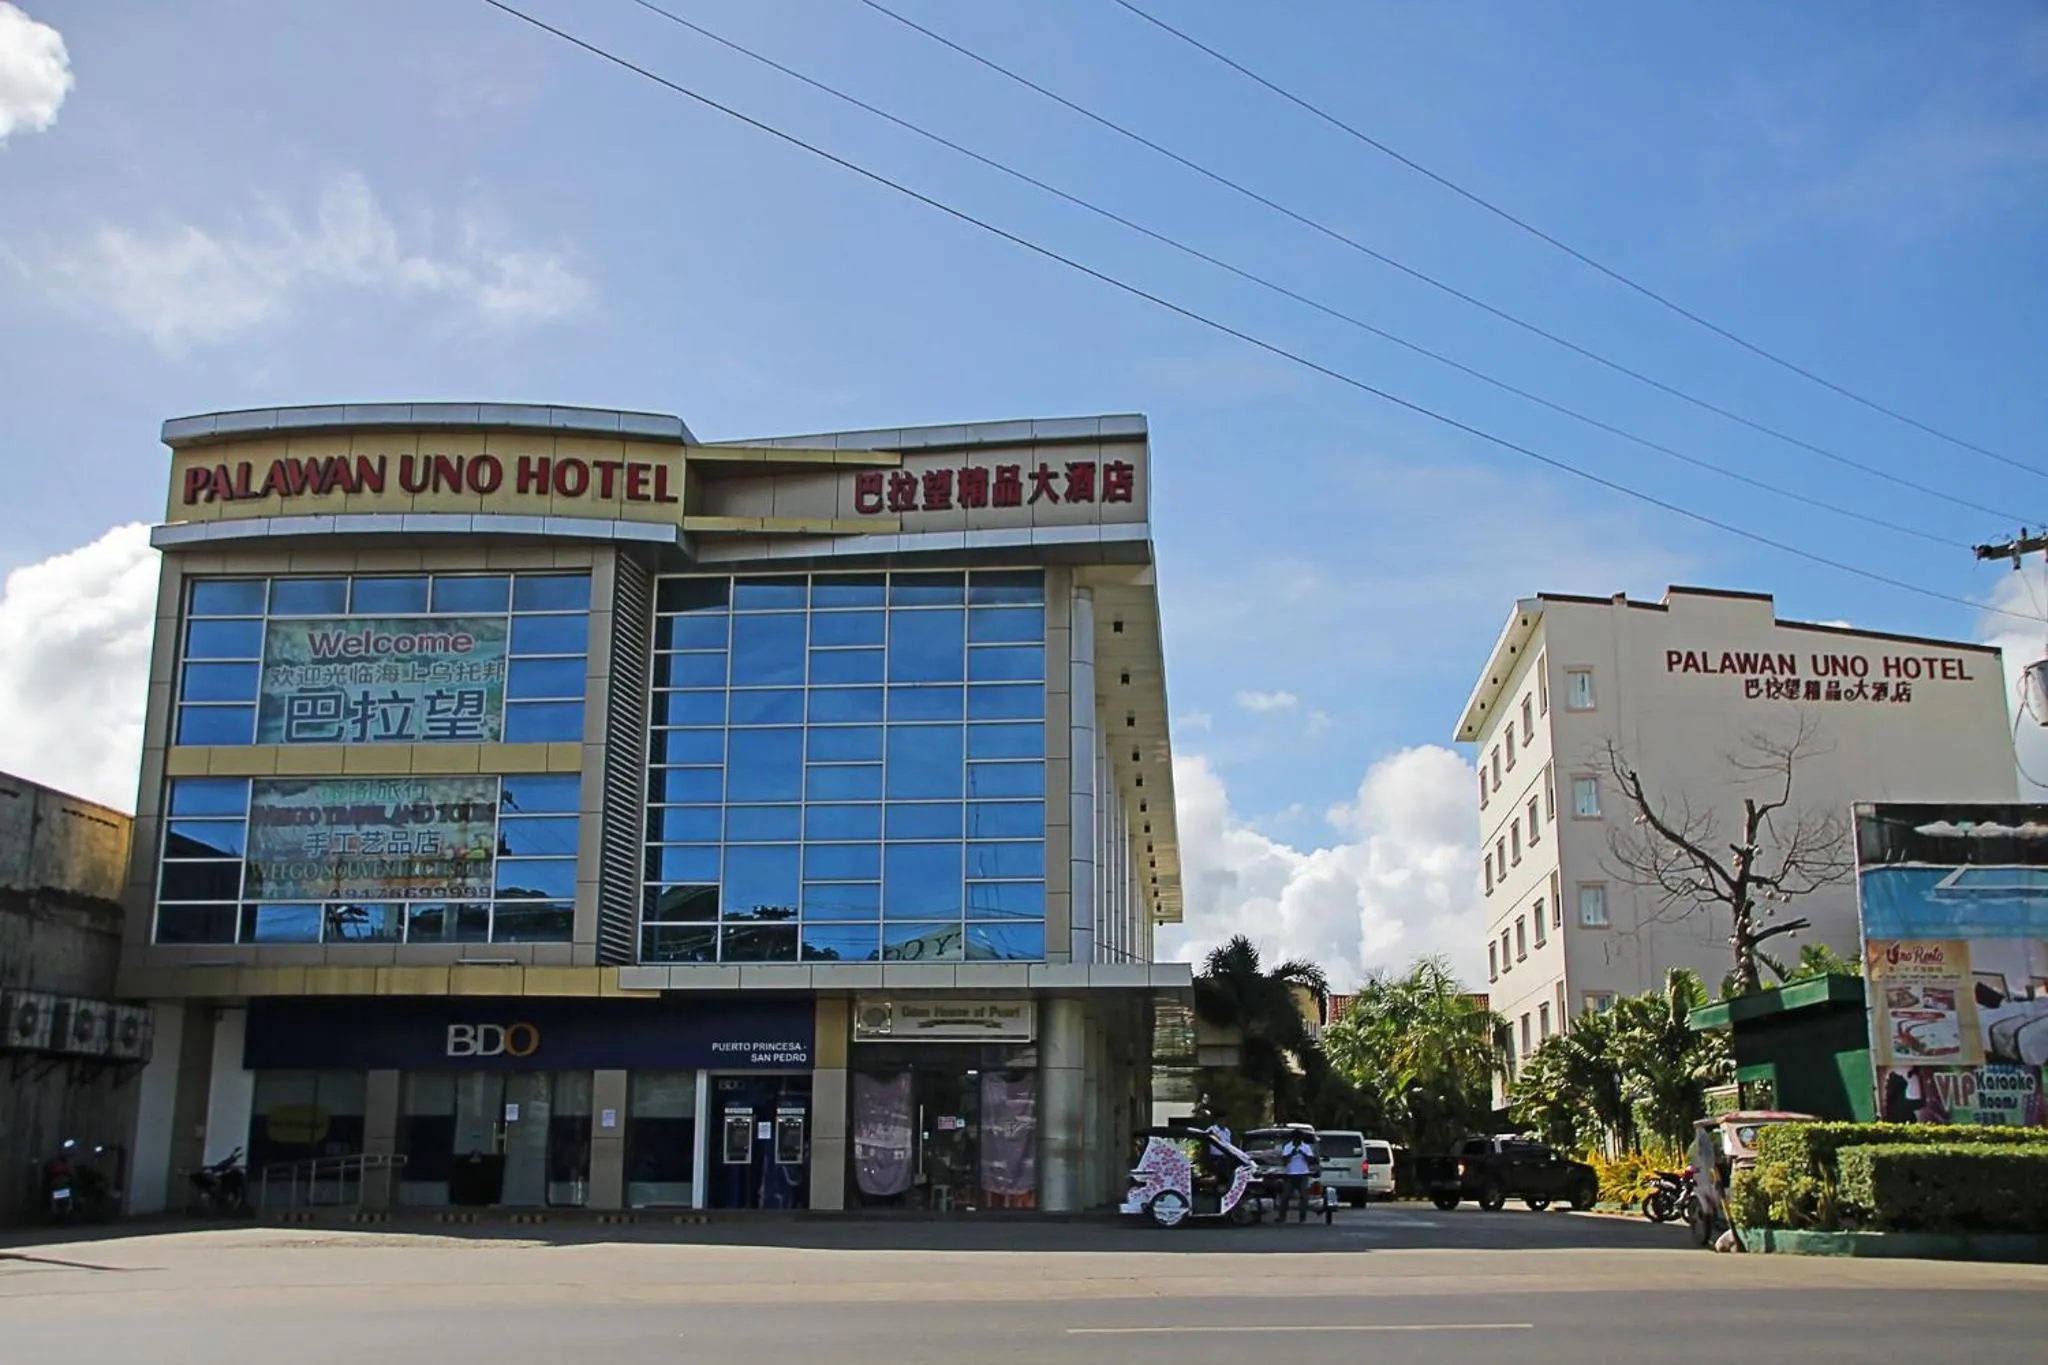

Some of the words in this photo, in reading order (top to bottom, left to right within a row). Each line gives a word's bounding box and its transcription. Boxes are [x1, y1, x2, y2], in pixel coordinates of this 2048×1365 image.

[183, 454, 386, 504] PALAWAN
[400, 454, 503, 495] UNO
[517, 455, 678, 503] HOTEL
[855, 460, 1134, 514] 巴拉望精品大酒店
[308, 630, 474, 657] Welcome
[1666, 650, 1796, 675] PALAWAN
[1812, 654, 1868, 678] UNO
[1884, 656, 1973, 680] HOTEL
[284, 688, 486, 743] 巴拉望
[303, 831, 441, 858] 手工艺品店
[447, 1022, 540, 1057] BDO
[712, 1042, 751, 1051] PUERTO
[751, 1053, 771, 1062] SAN
[773, 1053, 807, 1062] PEDRO
[1934, 1072, 1975, 1112] VIP
[1975, 1069, 2034, 1091] Karaoke
[1978, 1092, 2017, 1109] Rooms
